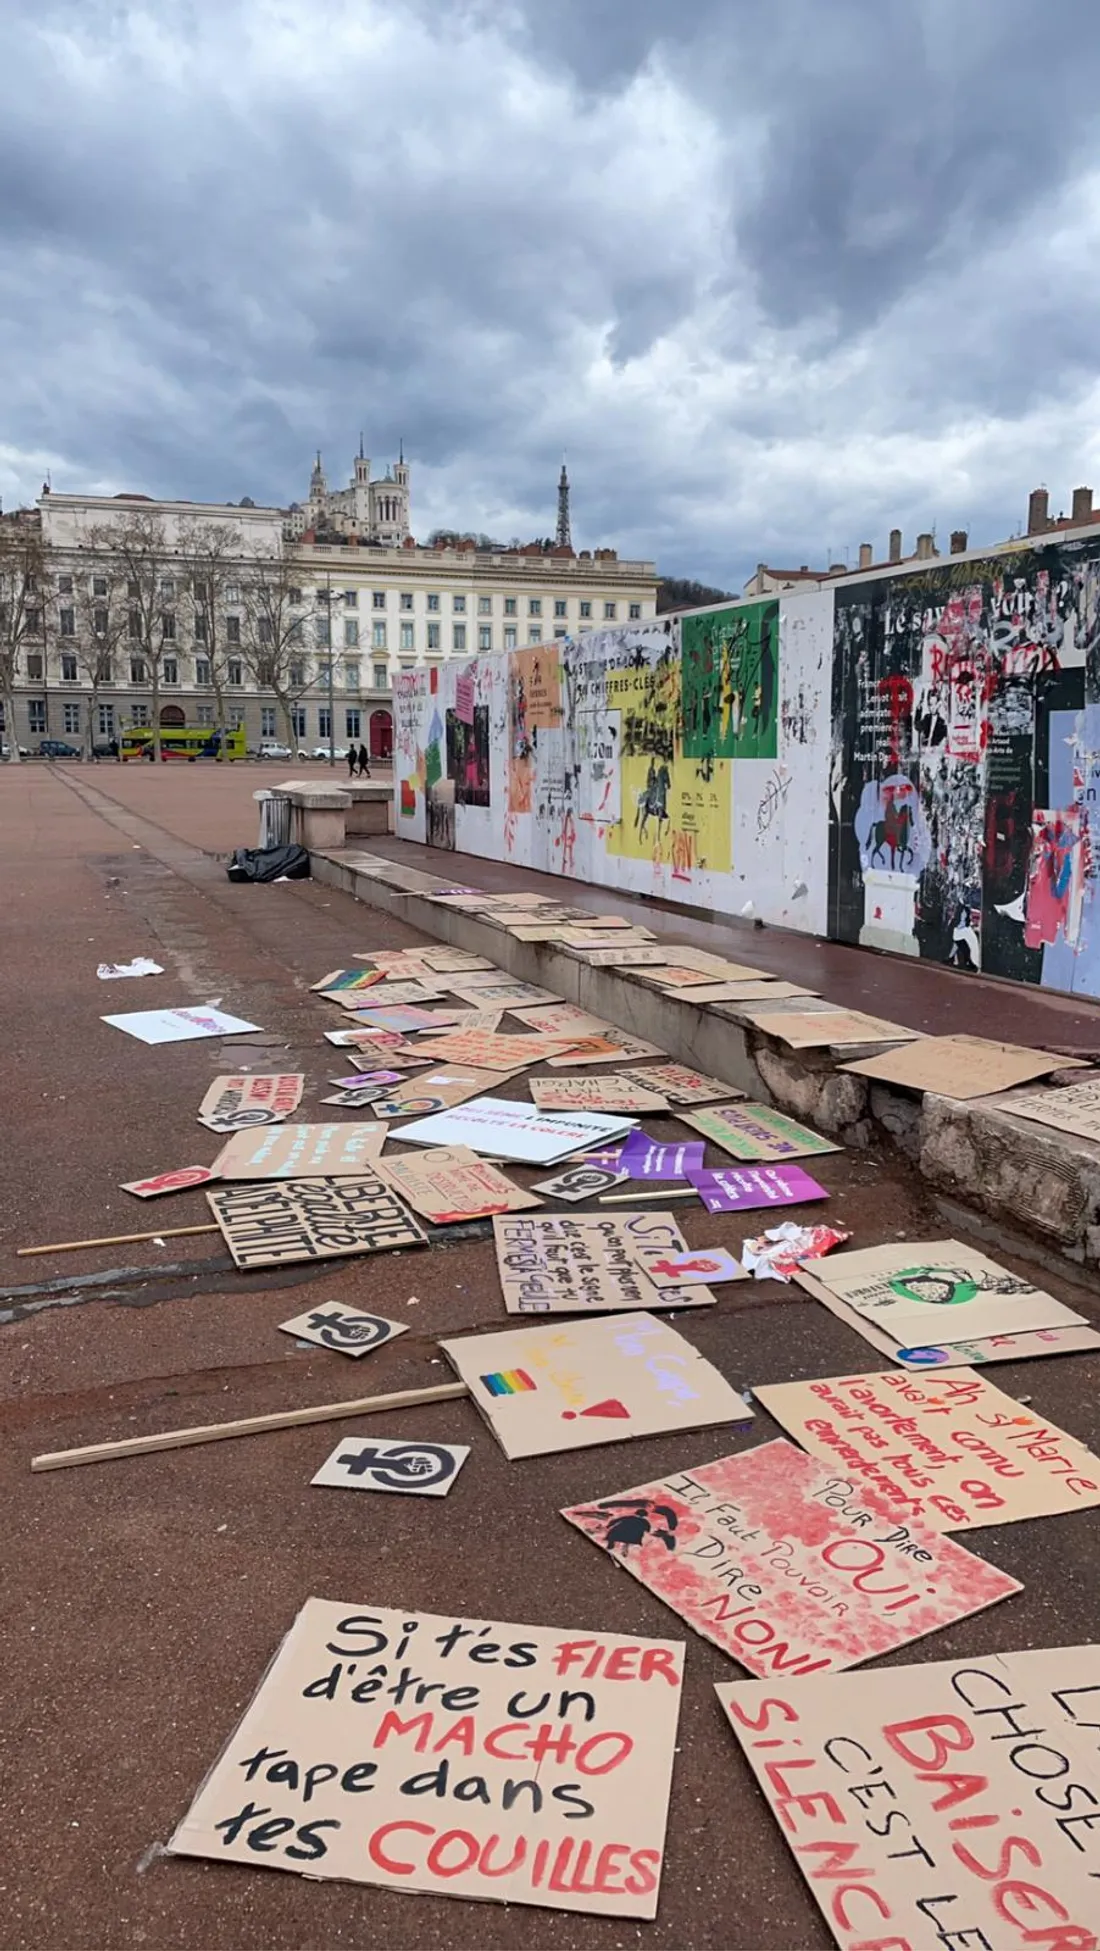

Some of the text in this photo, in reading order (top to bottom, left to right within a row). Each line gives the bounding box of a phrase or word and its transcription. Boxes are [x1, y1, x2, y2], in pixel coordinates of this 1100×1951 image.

[550, 1264, 574, 1285] que
[577, 1262, 602, 1276] le
[577, 1275, 606, 1304] signe
[808, 1382, 973, 1525] aurait pas tous ces
[924, 1378, 987, 1406] Ah
[1005, 1429, 1100, 1496] Marie
[950, 1429, 1026, 1479] connu
[704, 1503, 761, 1543] Faut
[958, 1478, 1007, 1510] on
[324, 1614, 420, 1661] Si
[551, 1639, 680, 1687] FIER
[301, 1661, 596, 1722] d'être un
[372, 1710, 635, 1777] MACHO
[951, 1668, 1100, 1852] CHOSE
[238, 1745, 596, 1820] tape dans
[823, 1736, 936, 1868] C'EST
[213, 1800, 663, 1897] tes COUILLES
